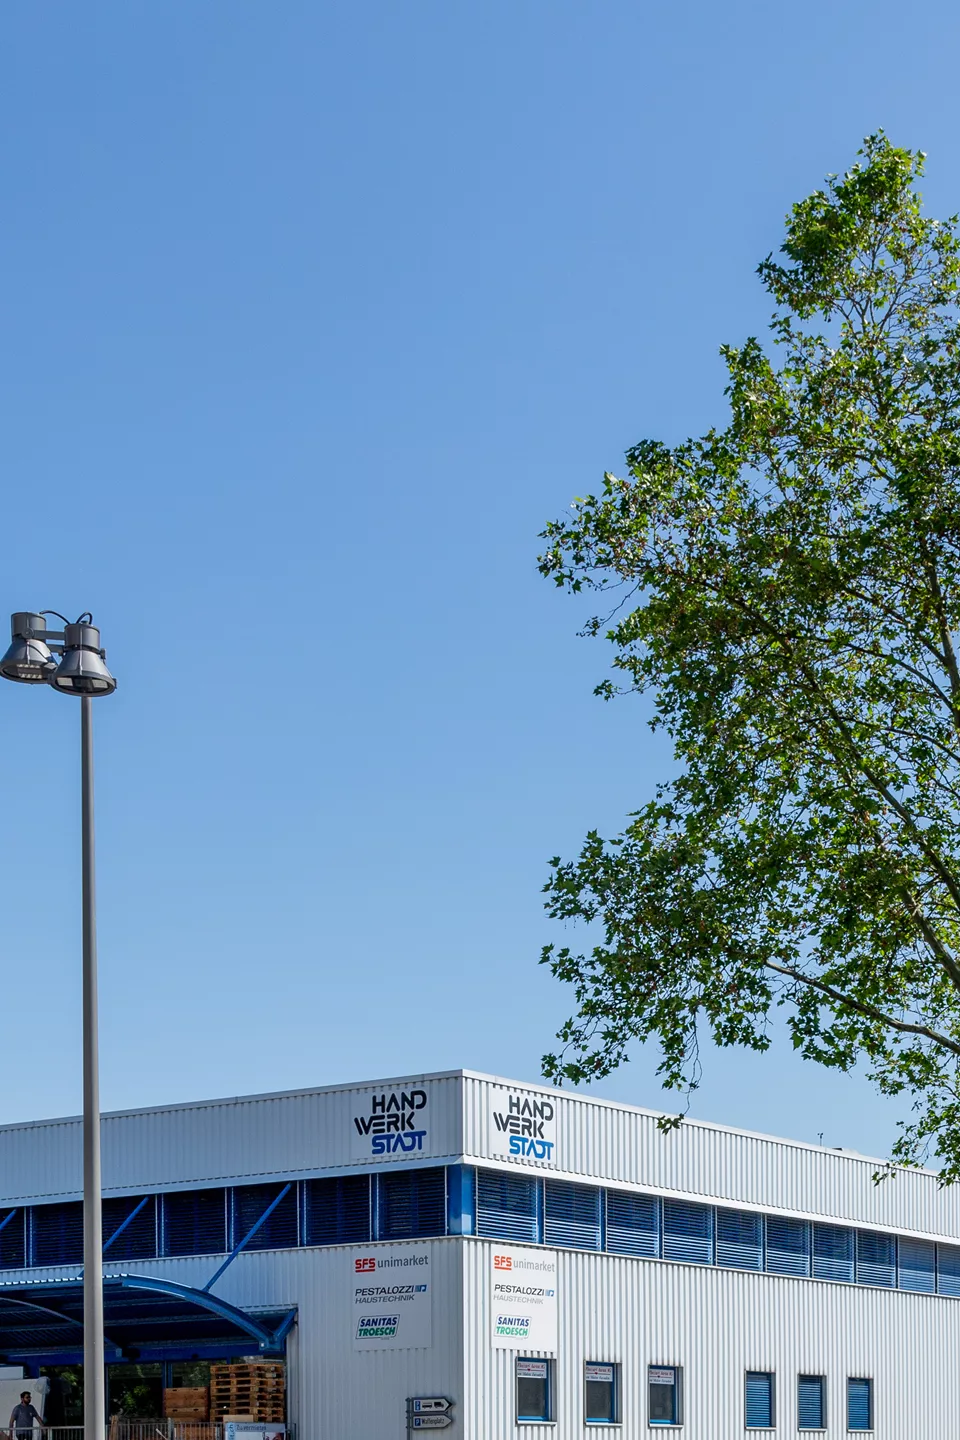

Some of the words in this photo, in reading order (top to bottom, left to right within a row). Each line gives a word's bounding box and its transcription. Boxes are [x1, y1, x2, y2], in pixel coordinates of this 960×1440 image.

[372, 1090, 427, 1115] HAND
[508, 1095, 554, 1121] HAND
[353, 1111, 415, 1136] WERK
[493, 1111, 545, 1139] WERK
[371, 1130, 428, 1155] STADT
[509, 1135, 554, 1161] STADT
[354, 1257, 376, 1270] SFS
[377, 1254, 429, 1268] unimarket
[493, 1255, 512, 1269] SFS
[513, 1256, 556, 1273] unimarket
[354, 1285, 415, 1297] PESTALOZZI
[494, 1284, 545, 1296] PESTALOZZI
[354, 1294, 415, 1304] HAUSTECHNIK
[493, 1294, 544, 1305] HAUSTECHNIK
[359, 1316, 398, 1327] SANITAS
[497, 1316, 530, 1327] SANITAS
[357, 1326, 397, 1337] TROESCH
[495, 1326, 529, 1337] TROESCH
